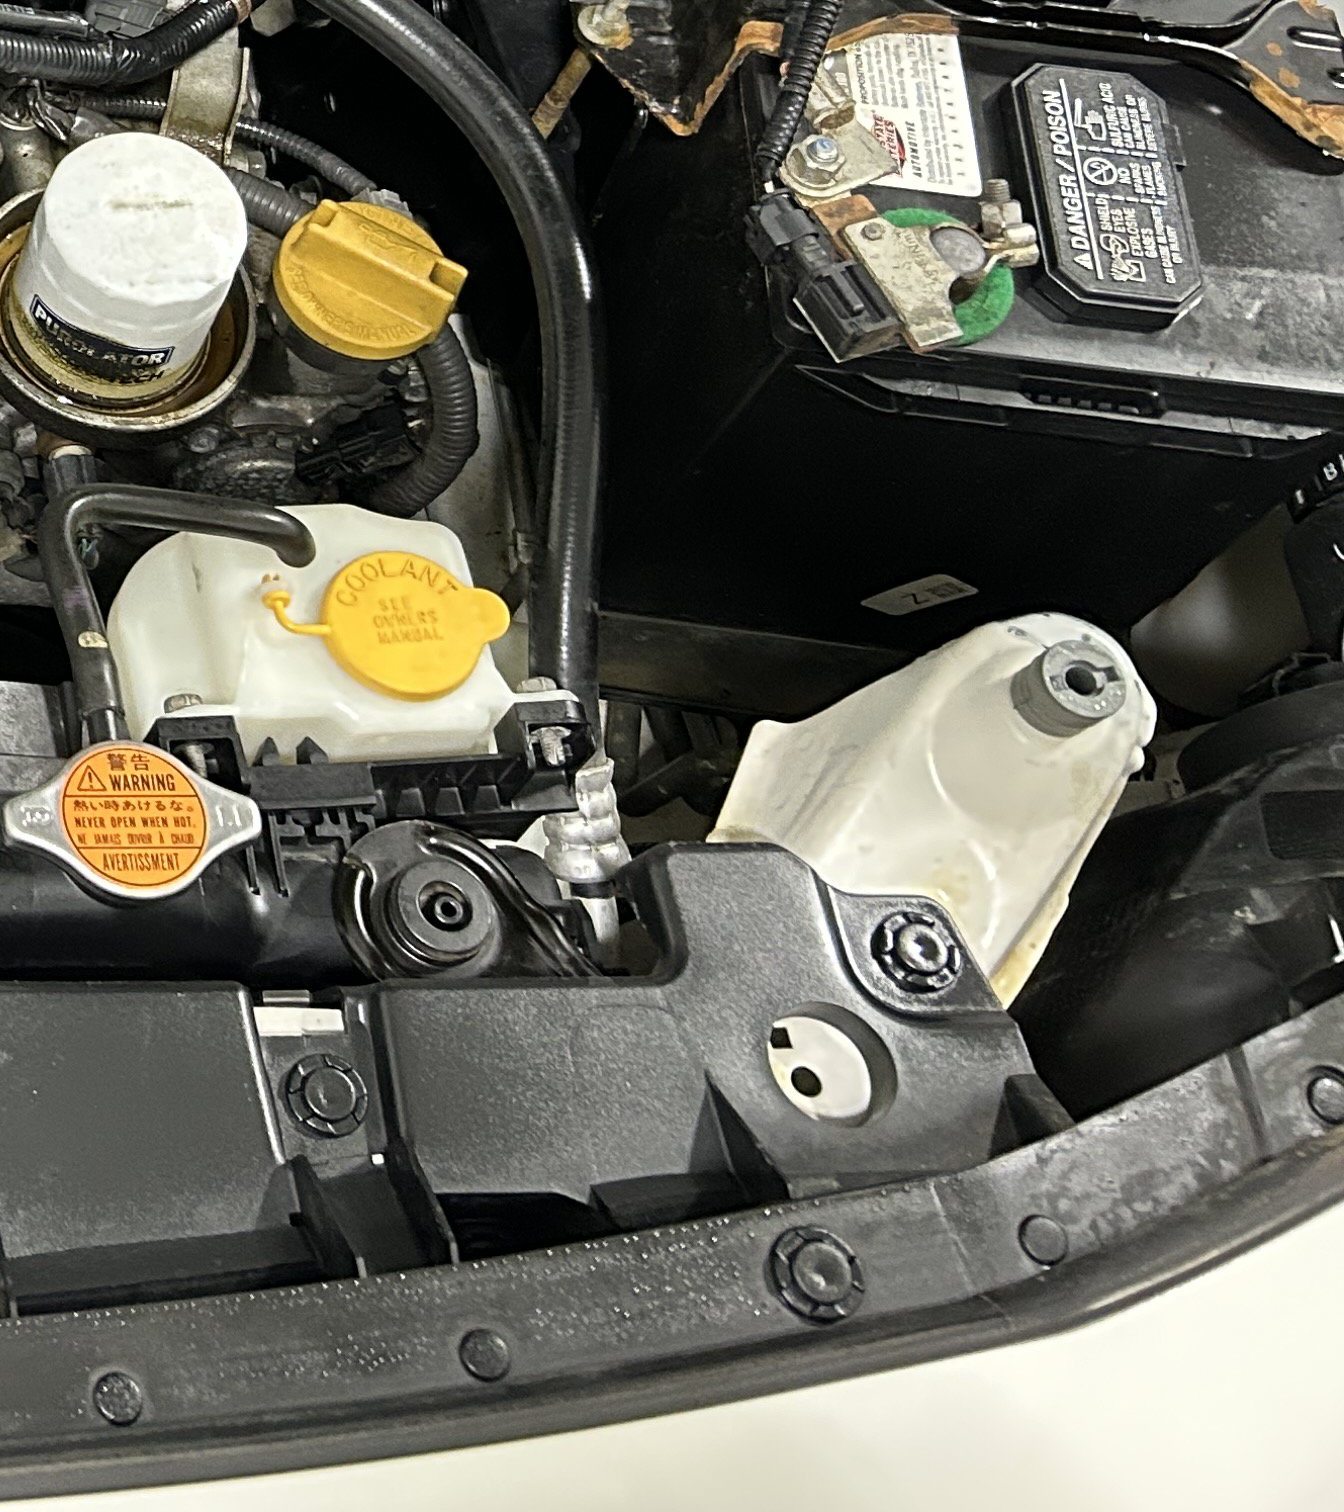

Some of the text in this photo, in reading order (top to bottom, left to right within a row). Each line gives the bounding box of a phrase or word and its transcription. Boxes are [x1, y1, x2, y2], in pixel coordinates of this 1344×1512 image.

[855, 54, 869, 103] PROPOSITION
[1044, 91, 1071, 156] POISON
[1100, 83, 1123, 147] SULFURIC ACID
[906, 120, 923, 177] AUTOMOTIVE
[1124, 132, 1134, 148] CAN
[1120, 169, 1131, 184] NO
[1131, 163, 1144, 194] SPARKS
[1143, 166, 1155, 195] FLAMES
[1059, 175, 1089, 250] DANGER
[1097, 199, 1112, 230] SHIELD
[1113, 210, 1125, 232] EYES
[1125, 209, 1142, 257] EXPLOSIVE
[1142, 229, 1156, 258] GASES
[336, 557, 460, 607] COOLANT
[379, 598, 412, 611] SEE
[377, 628, 444, 645] MANUAL
[106, 753, 150, 771] 警告
[109, 773, 176, 792] WARNING
[74, 816, 106, 829] NEVER
[110, 816, 136, 828] OPEN
[140, 816, 169, 828] WHEN
[102, 852, 180, 872] AVERTISSMENT
